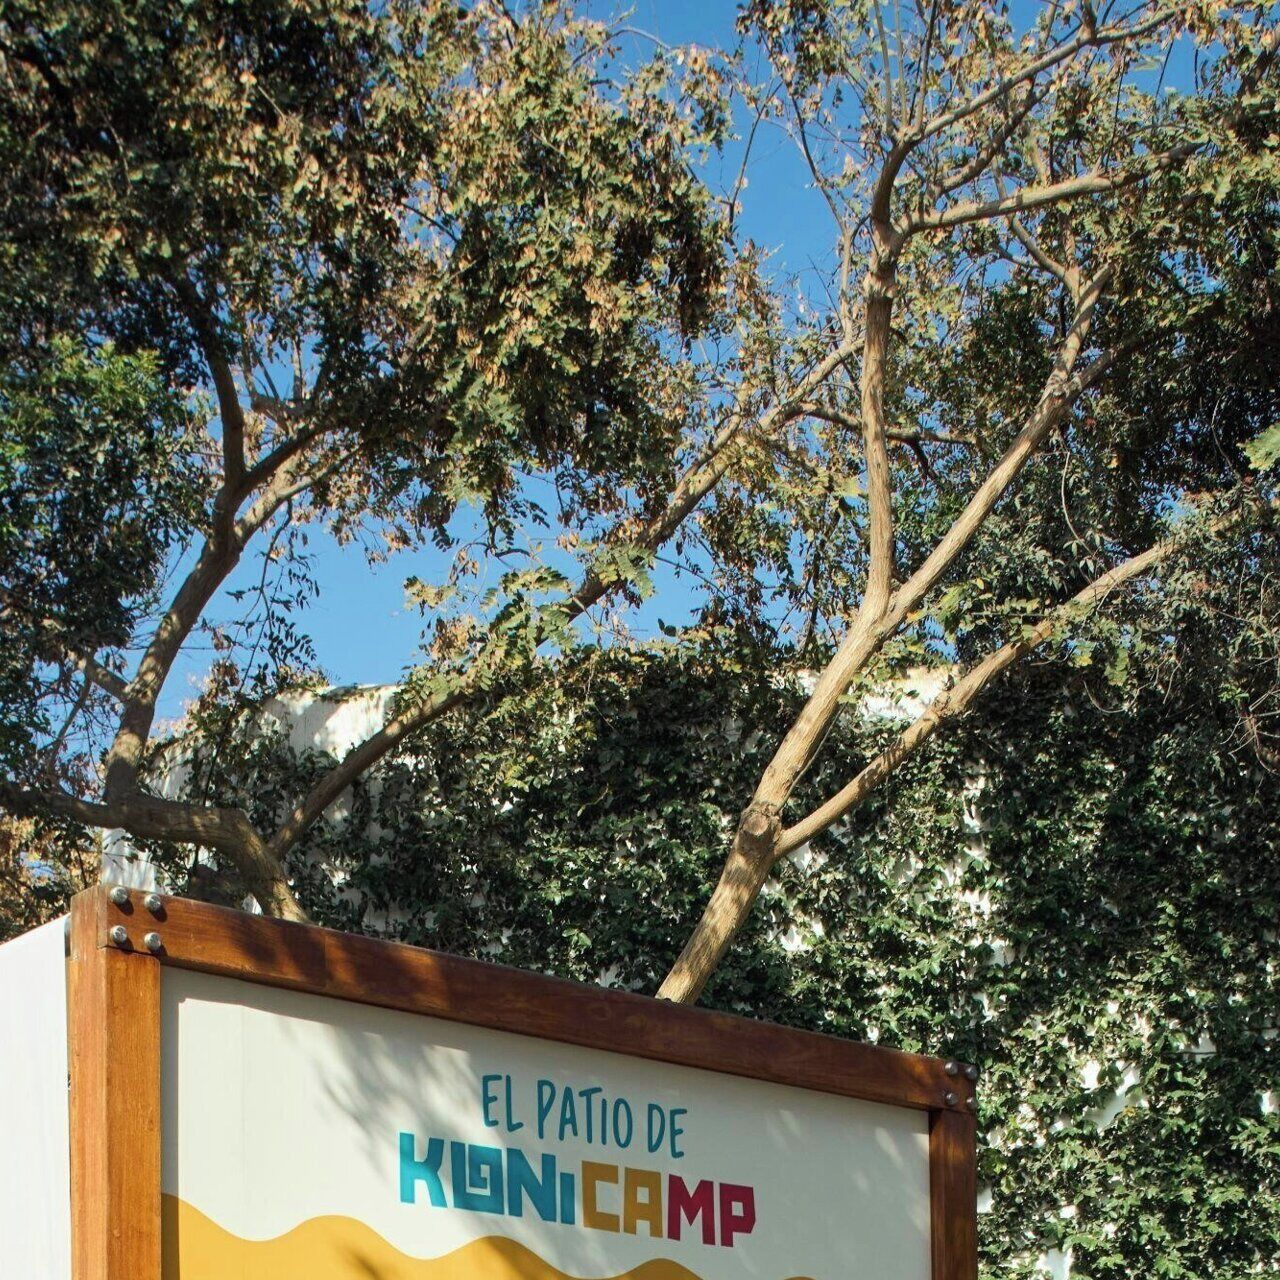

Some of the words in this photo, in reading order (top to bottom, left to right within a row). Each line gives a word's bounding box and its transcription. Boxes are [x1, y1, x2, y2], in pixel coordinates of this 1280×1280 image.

[482, 1074, 524, 1131] EL
[537, 1079, 634, 1149] PATIO
[647, 1103, 688, 1159] DE
